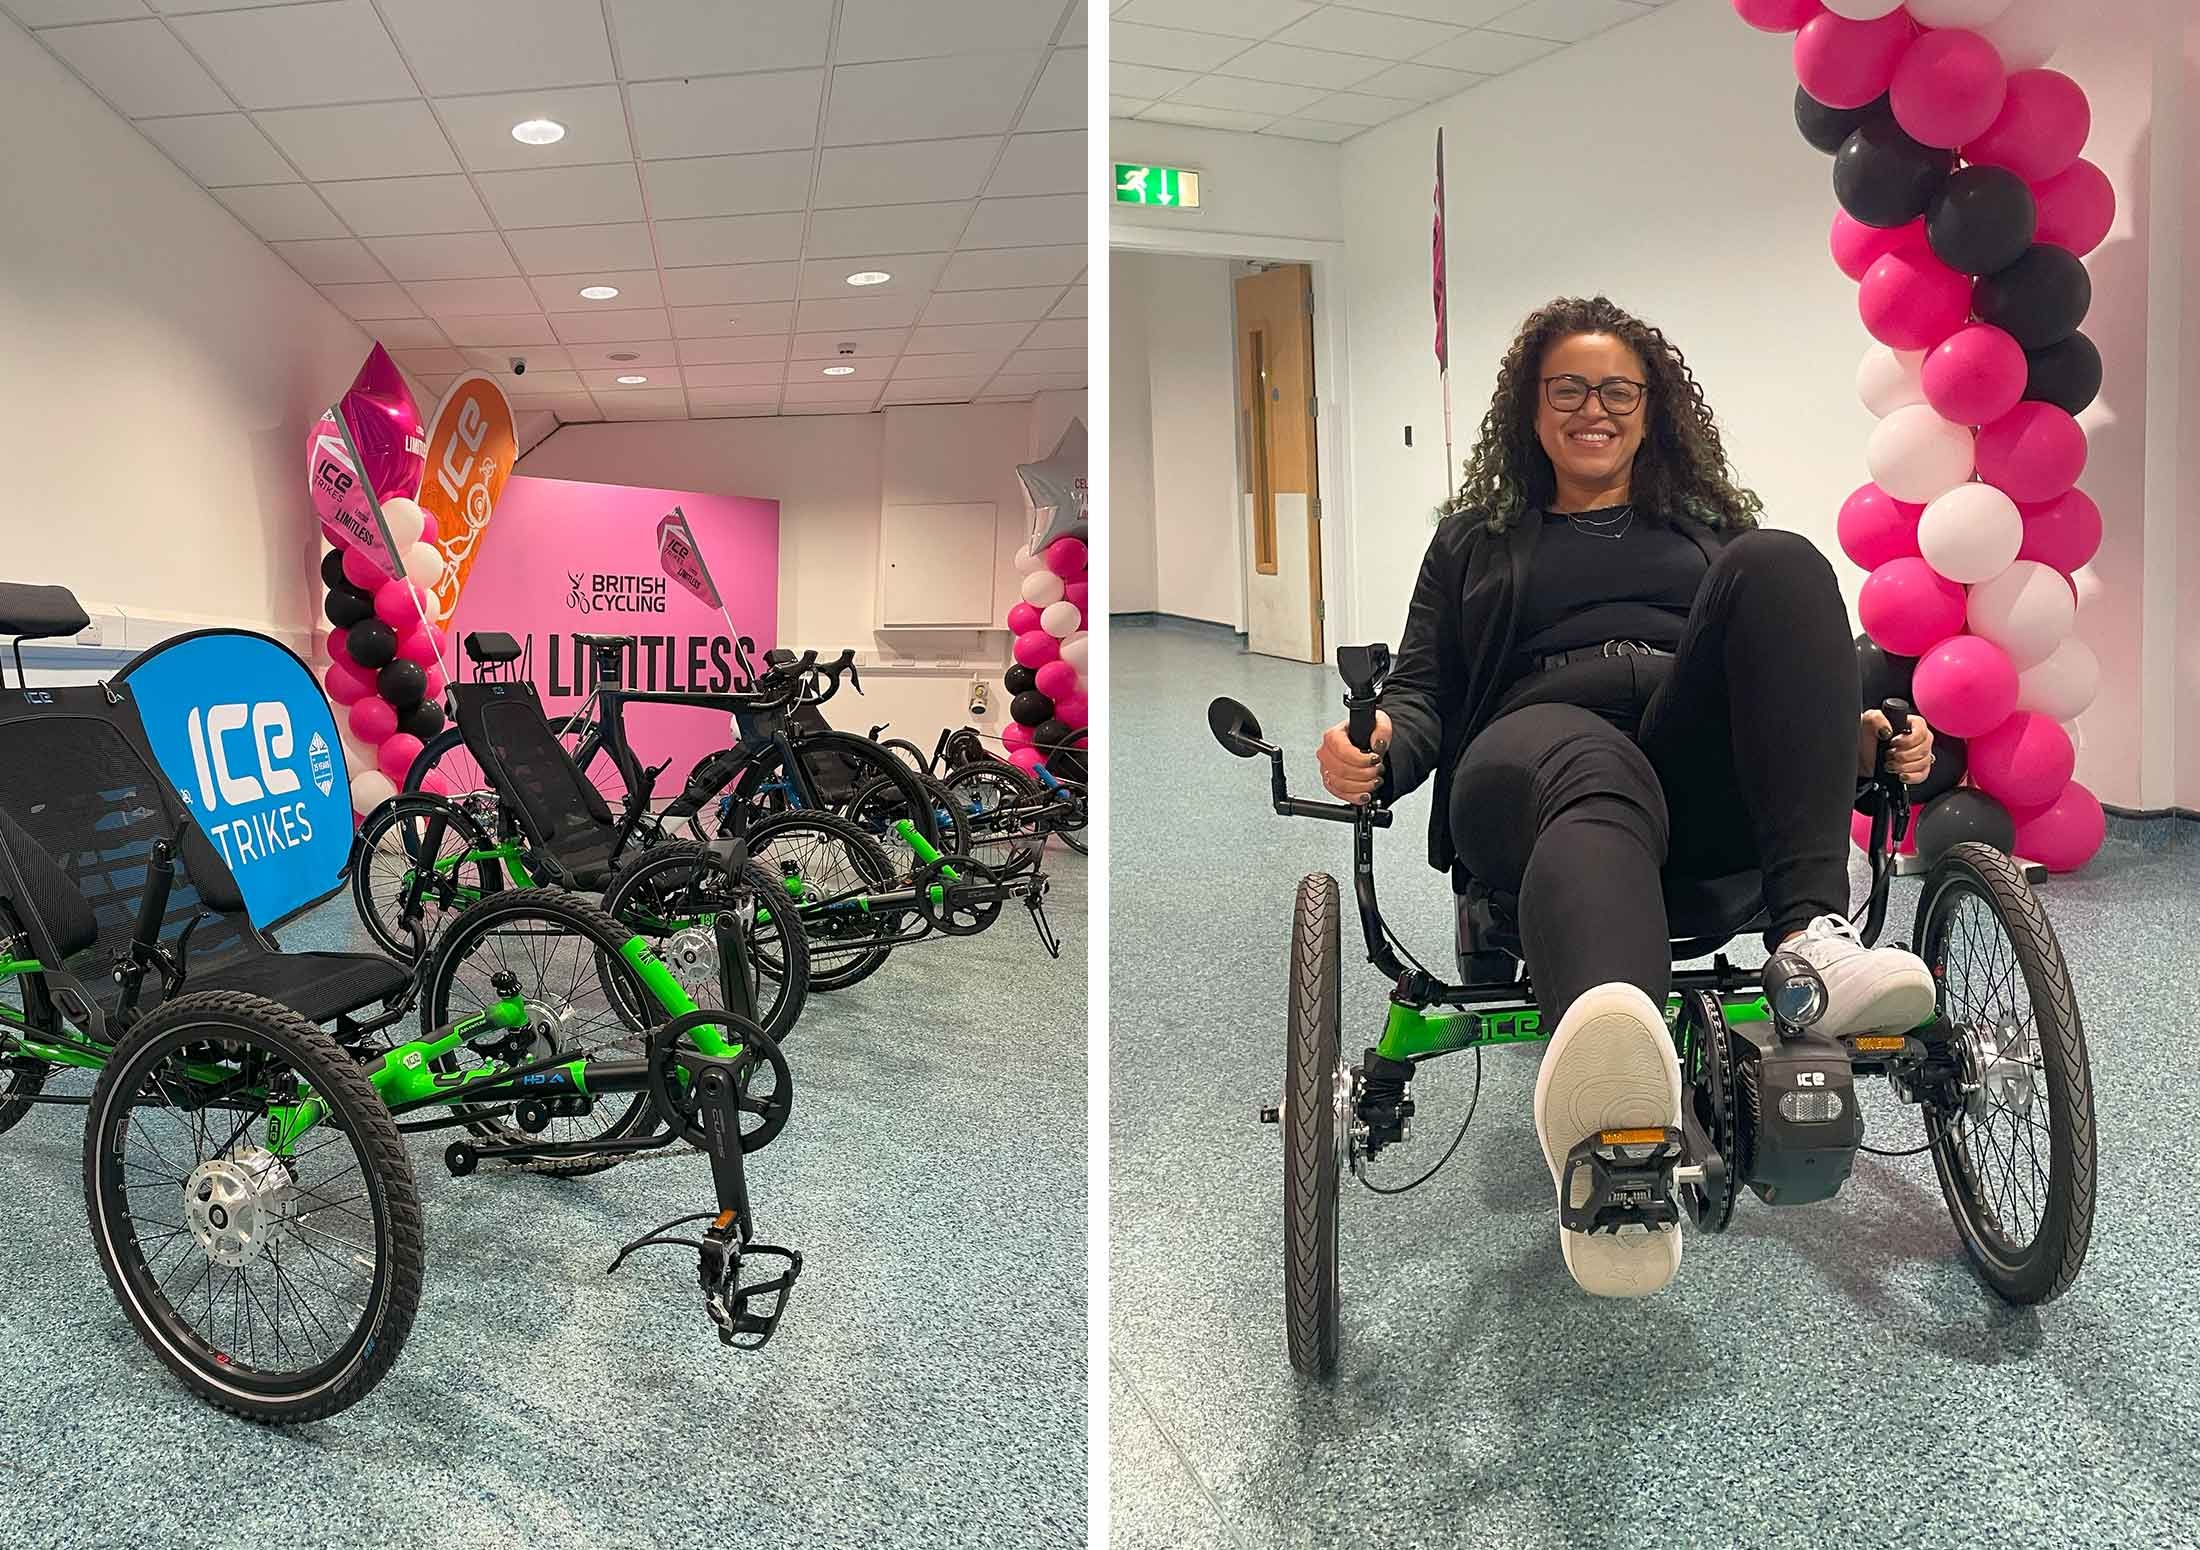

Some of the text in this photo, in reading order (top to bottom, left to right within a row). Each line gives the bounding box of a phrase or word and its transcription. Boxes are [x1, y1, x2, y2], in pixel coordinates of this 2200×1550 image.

[315, 474, 345, 503] TRIKES
[335, 508, 374, 546] LIMITLESS
[592, 574, 665, 594] BRITISH
[592, 594, 665, 613] CYCLING
[188, 701, 301, 812] ICE
[210, 802, 313, 871] TRIKES
[1796, 1072, 1825, 1087] ICE
